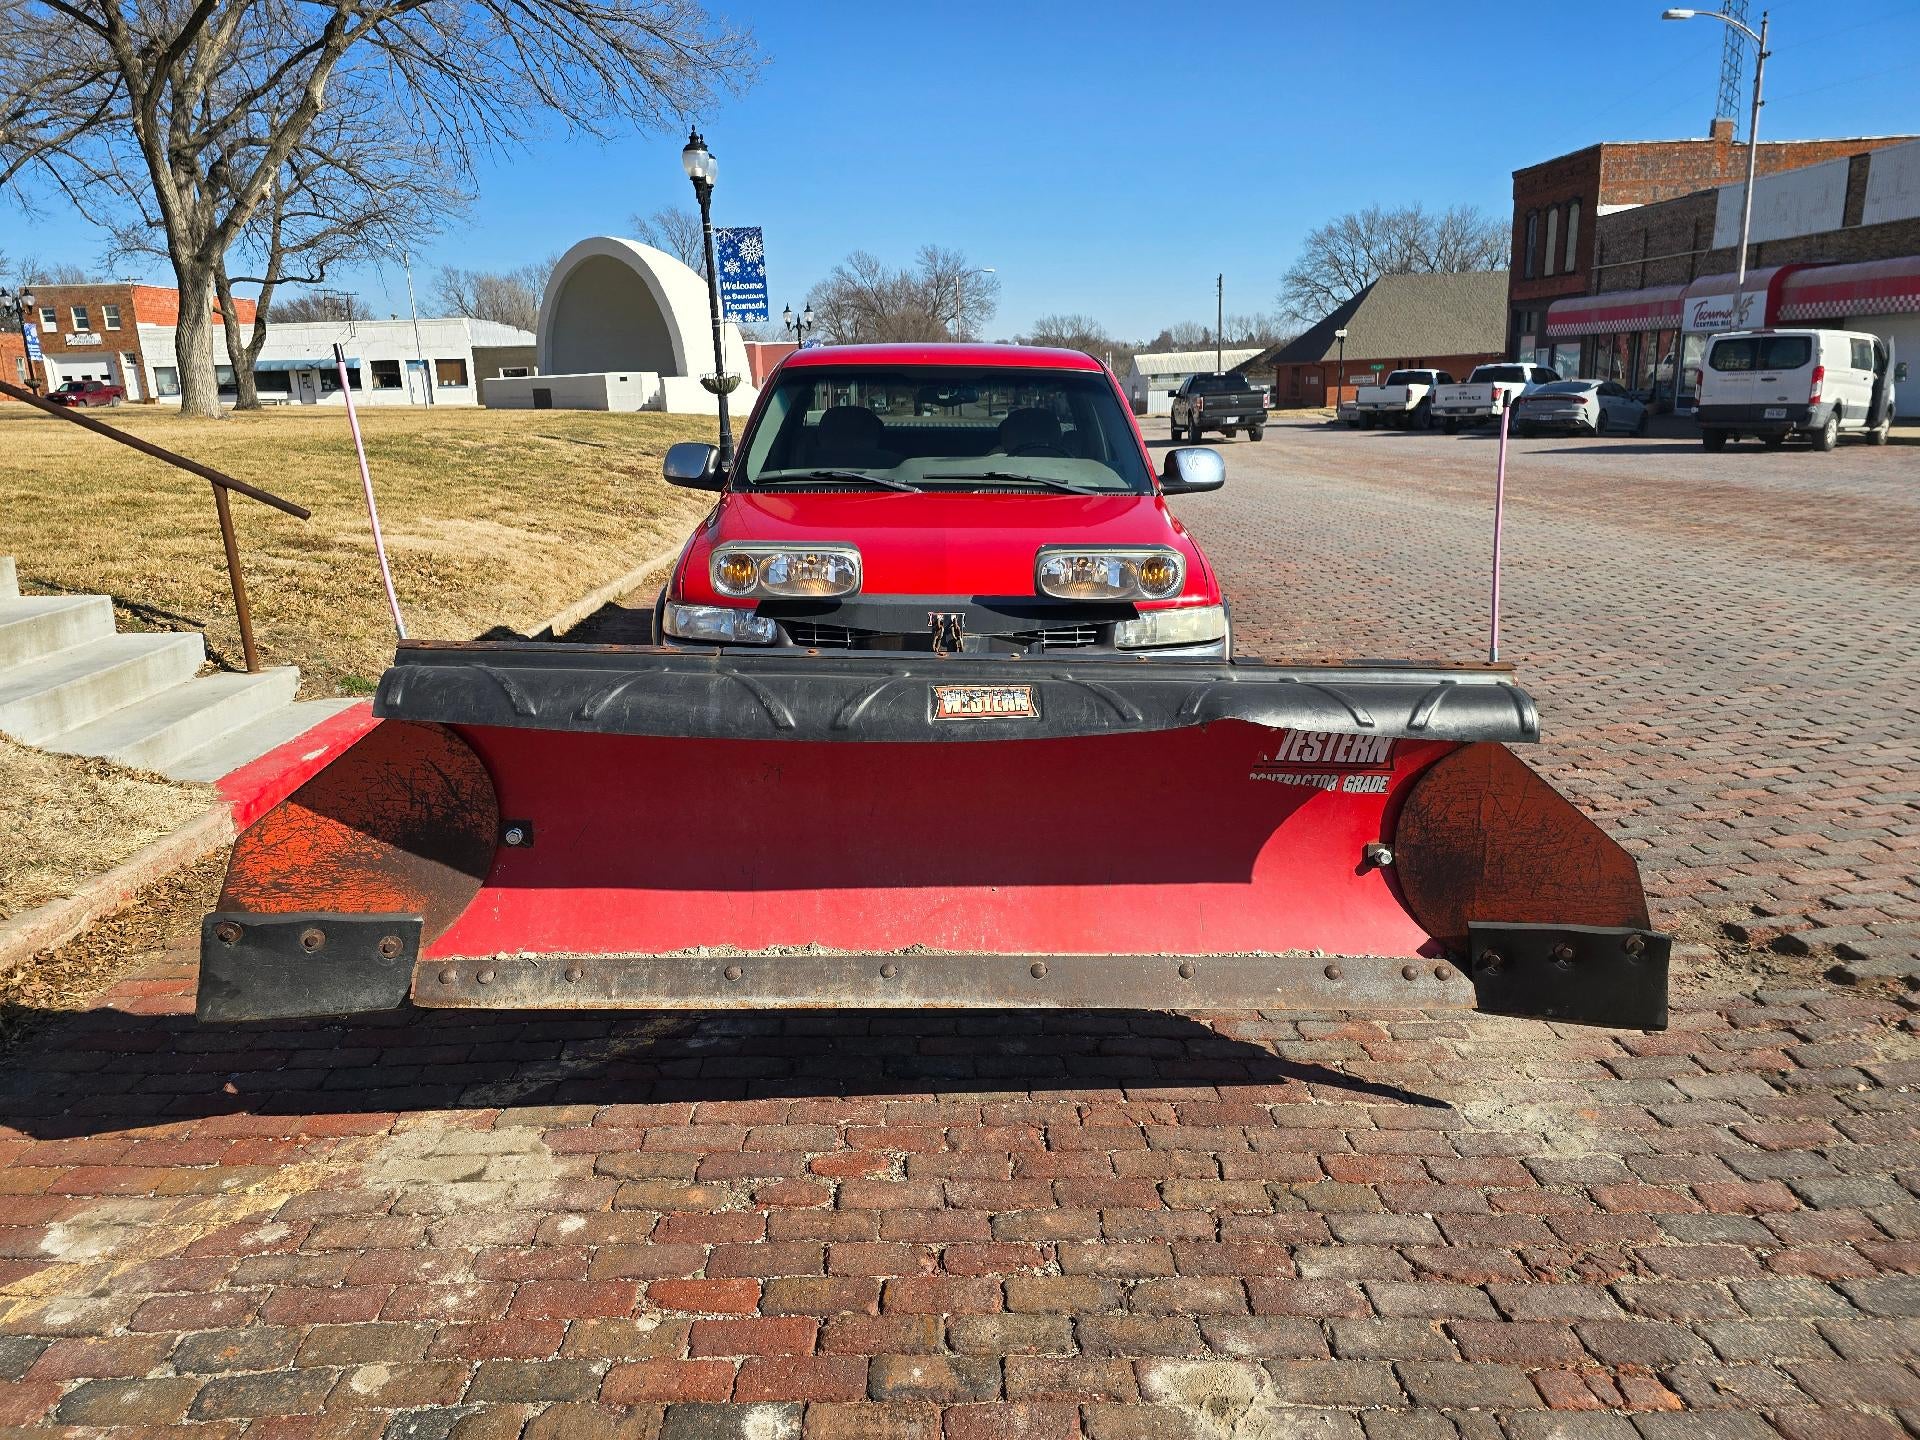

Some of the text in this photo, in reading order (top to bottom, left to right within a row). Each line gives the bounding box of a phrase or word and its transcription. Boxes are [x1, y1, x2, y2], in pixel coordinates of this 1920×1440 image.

[722, 281, 764, 290] Welcome
[726, 300, 767, 310] Tecumseh
[942, 689, 1030, 714] WESTERN
[1343, 774, 1390, 793] GRADE
